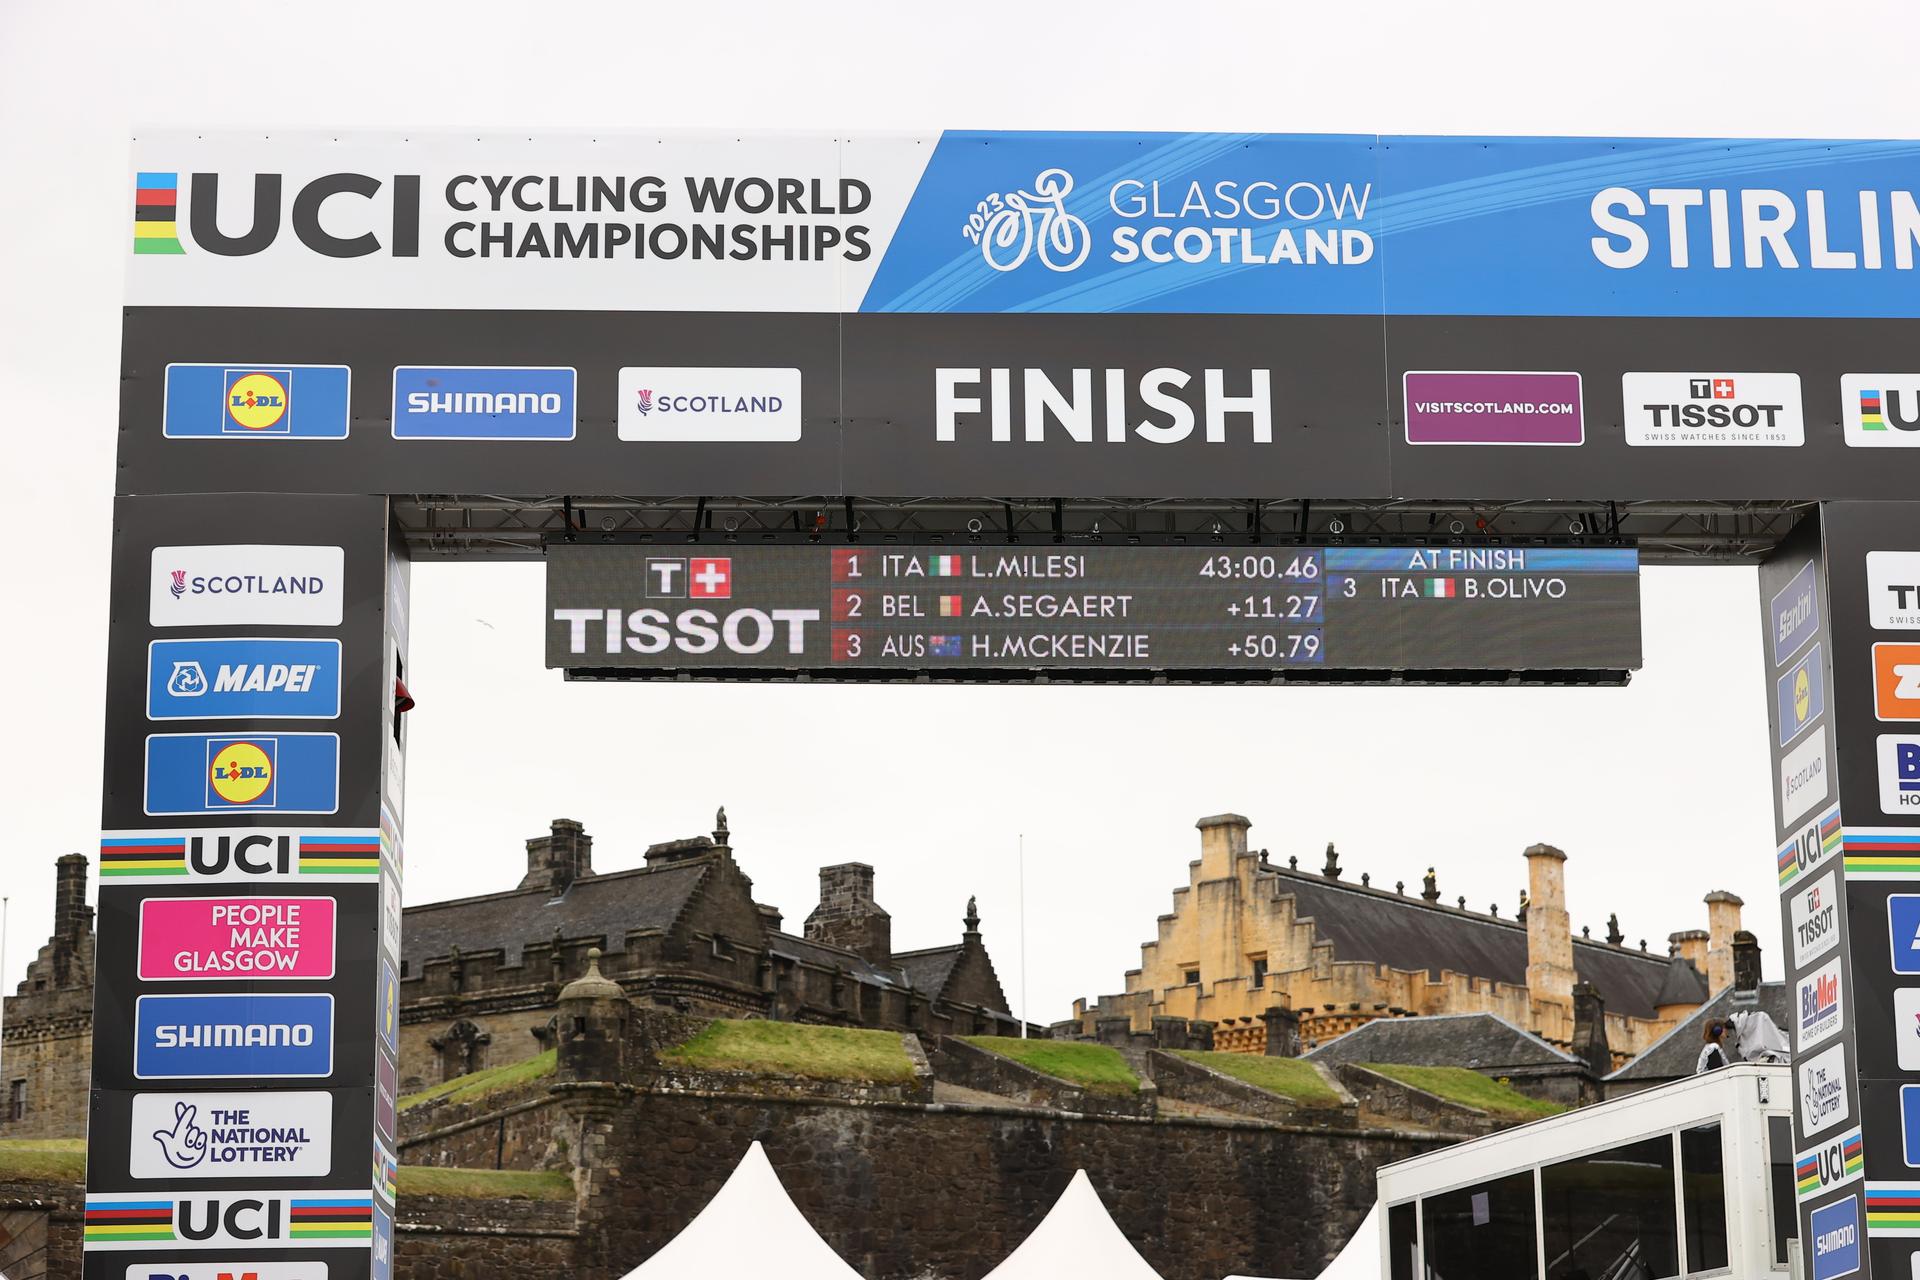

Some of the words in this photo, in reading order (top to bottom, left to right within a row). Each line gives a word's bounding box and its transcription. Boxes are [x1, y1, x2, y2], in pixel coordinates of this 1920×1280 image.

[445, 175, 667, 213] CYCLING
[684, 176, 872, 215] WORLD
[1109, 179, 1371, 221] GLASGOW
[190, 173, 420, 258] UCI
[963, 192, 1005, 246] 2023
[445, 221, 872, 262] CHAMPIONSHIPS
[1110, 226, 1374, 265] SCOTLAND
[408, 390, 561, 415] SHIMANO
[657, 396, 783, 413] SCOTLAND
[935, 367, 1273, 444] FINISH
[1414, 402, 1573, 415] VISITSCOTLAND.COM
[1643, 403, 1784, 428] TISSOT
[1644, 432, 1677, 441] SWISS
[1680, 433, 1727, 441] WATCHES
[1731, 433, 1760, 441] SINCE
[1765, 433, 1786, 441] 1853
[847, 555, 862, 577] 1
[882, 555, 925, 577] ITA
[971, 555, 1085, 578] L.MILESI
[1199, 555, 1318, 579] 43:00.46
[1407, 549, 1442, 570] AT
[1449, 549, 1525, 570] FINISH
[191, 575, 324, 595] SCOTLAND
[1343, 577, 1357, 598] 3
[1381, 577, 1419, 598] ITA
[1464, 578, 1567, 599] B.OLIVO
[846, 594, 862, 617] 2
[882, 594, 925, 617] BEL
[970, 594, 1133, 618] A.SEGAERT
[1227, 595, 1319, 618] +11.27
[1779, 585, 1811, 643] Santini
[553, 608, 820, 654] TISSOT
[846, 634, 861, 657] 3
[881, 634, 925, 658] AUS
[972, 634, 1149, 658] H.MCKENZIE
[1228, 634, 1320, 658] +50.79
[213, 664, 317, 693] MAPEI
[1790, 757, 1822, 794] SCOTLAND
[190, 834, 290, 876] UCI
[1796, 824, 1822, 871] UCI
[212, 904, 301, 926] PEOPLE
[1798, 905, 1833, 948] TISSOT
[230, 927, 300, 948] MAKE
[174, 950, 300, 972] GLASGOW
[1801, 973, 1838, 1023] BigMat
[155, 1024, 313, 1048] SHIMANO
[210, 1109, 250, 1125] THE
[211, 1127, 311, 1144] NATIONAL
[210, 1146, 299, 1163] LOTTERY
[1818, 1143, 1845, 1186] UCI
[178, 1199, 281, 1241] UCI
[1816, 1223, 1855, 1256] SHIMANO
